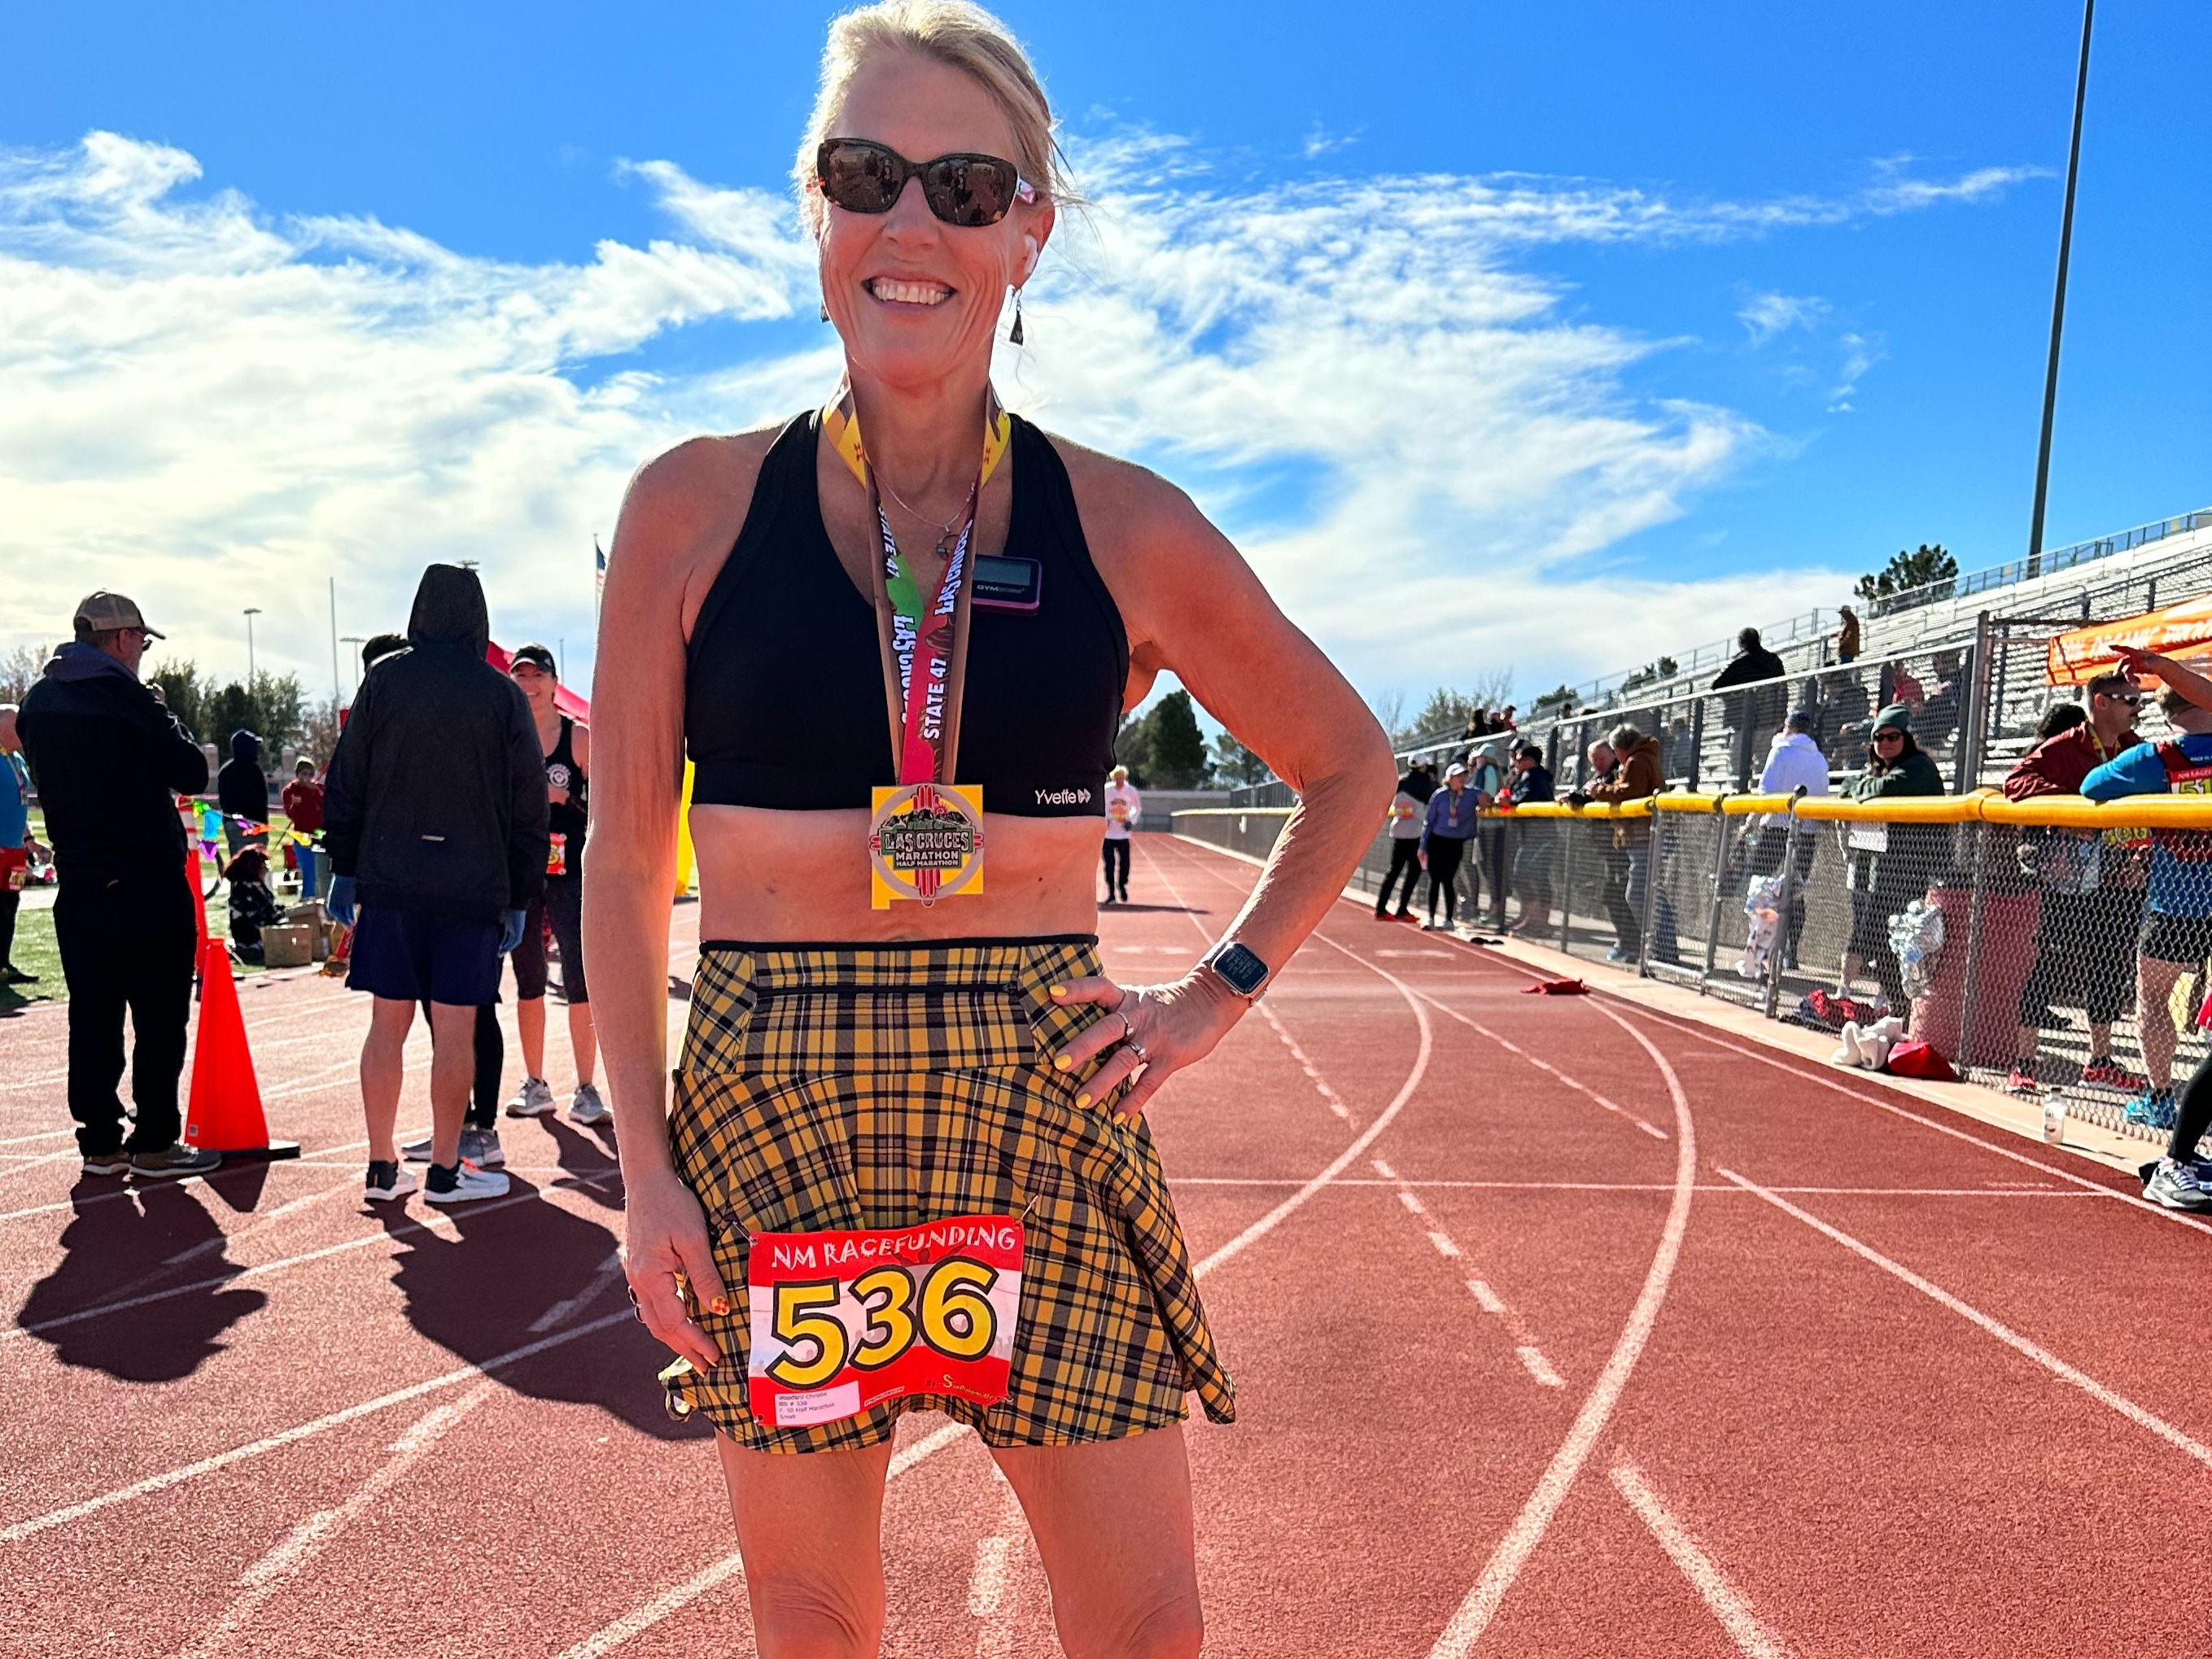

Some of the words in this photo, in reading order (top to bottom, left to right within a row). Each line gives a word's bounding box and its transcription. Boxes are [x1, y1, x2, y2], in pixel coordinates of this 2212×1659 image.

[885, 557, 900, 578] 47
[933, 578, 962, 616] LAS
[892, 614, 917, 652] LAS
[929, 657, 948, 679] 47
[923, 683, 944, 740] STATE
[1035, 789, 1077, 805] Yvette
[885, 832, 914, 853] LAS
[916, 832, 969, 852] CRUCES
[895, 851, 959, 861] MARATHON
[771, 1242, 816, 1270] NM
[824, 1223, 1016, 1267] RACEFUNDING
[763, 1255, 1000, 1390] 536
